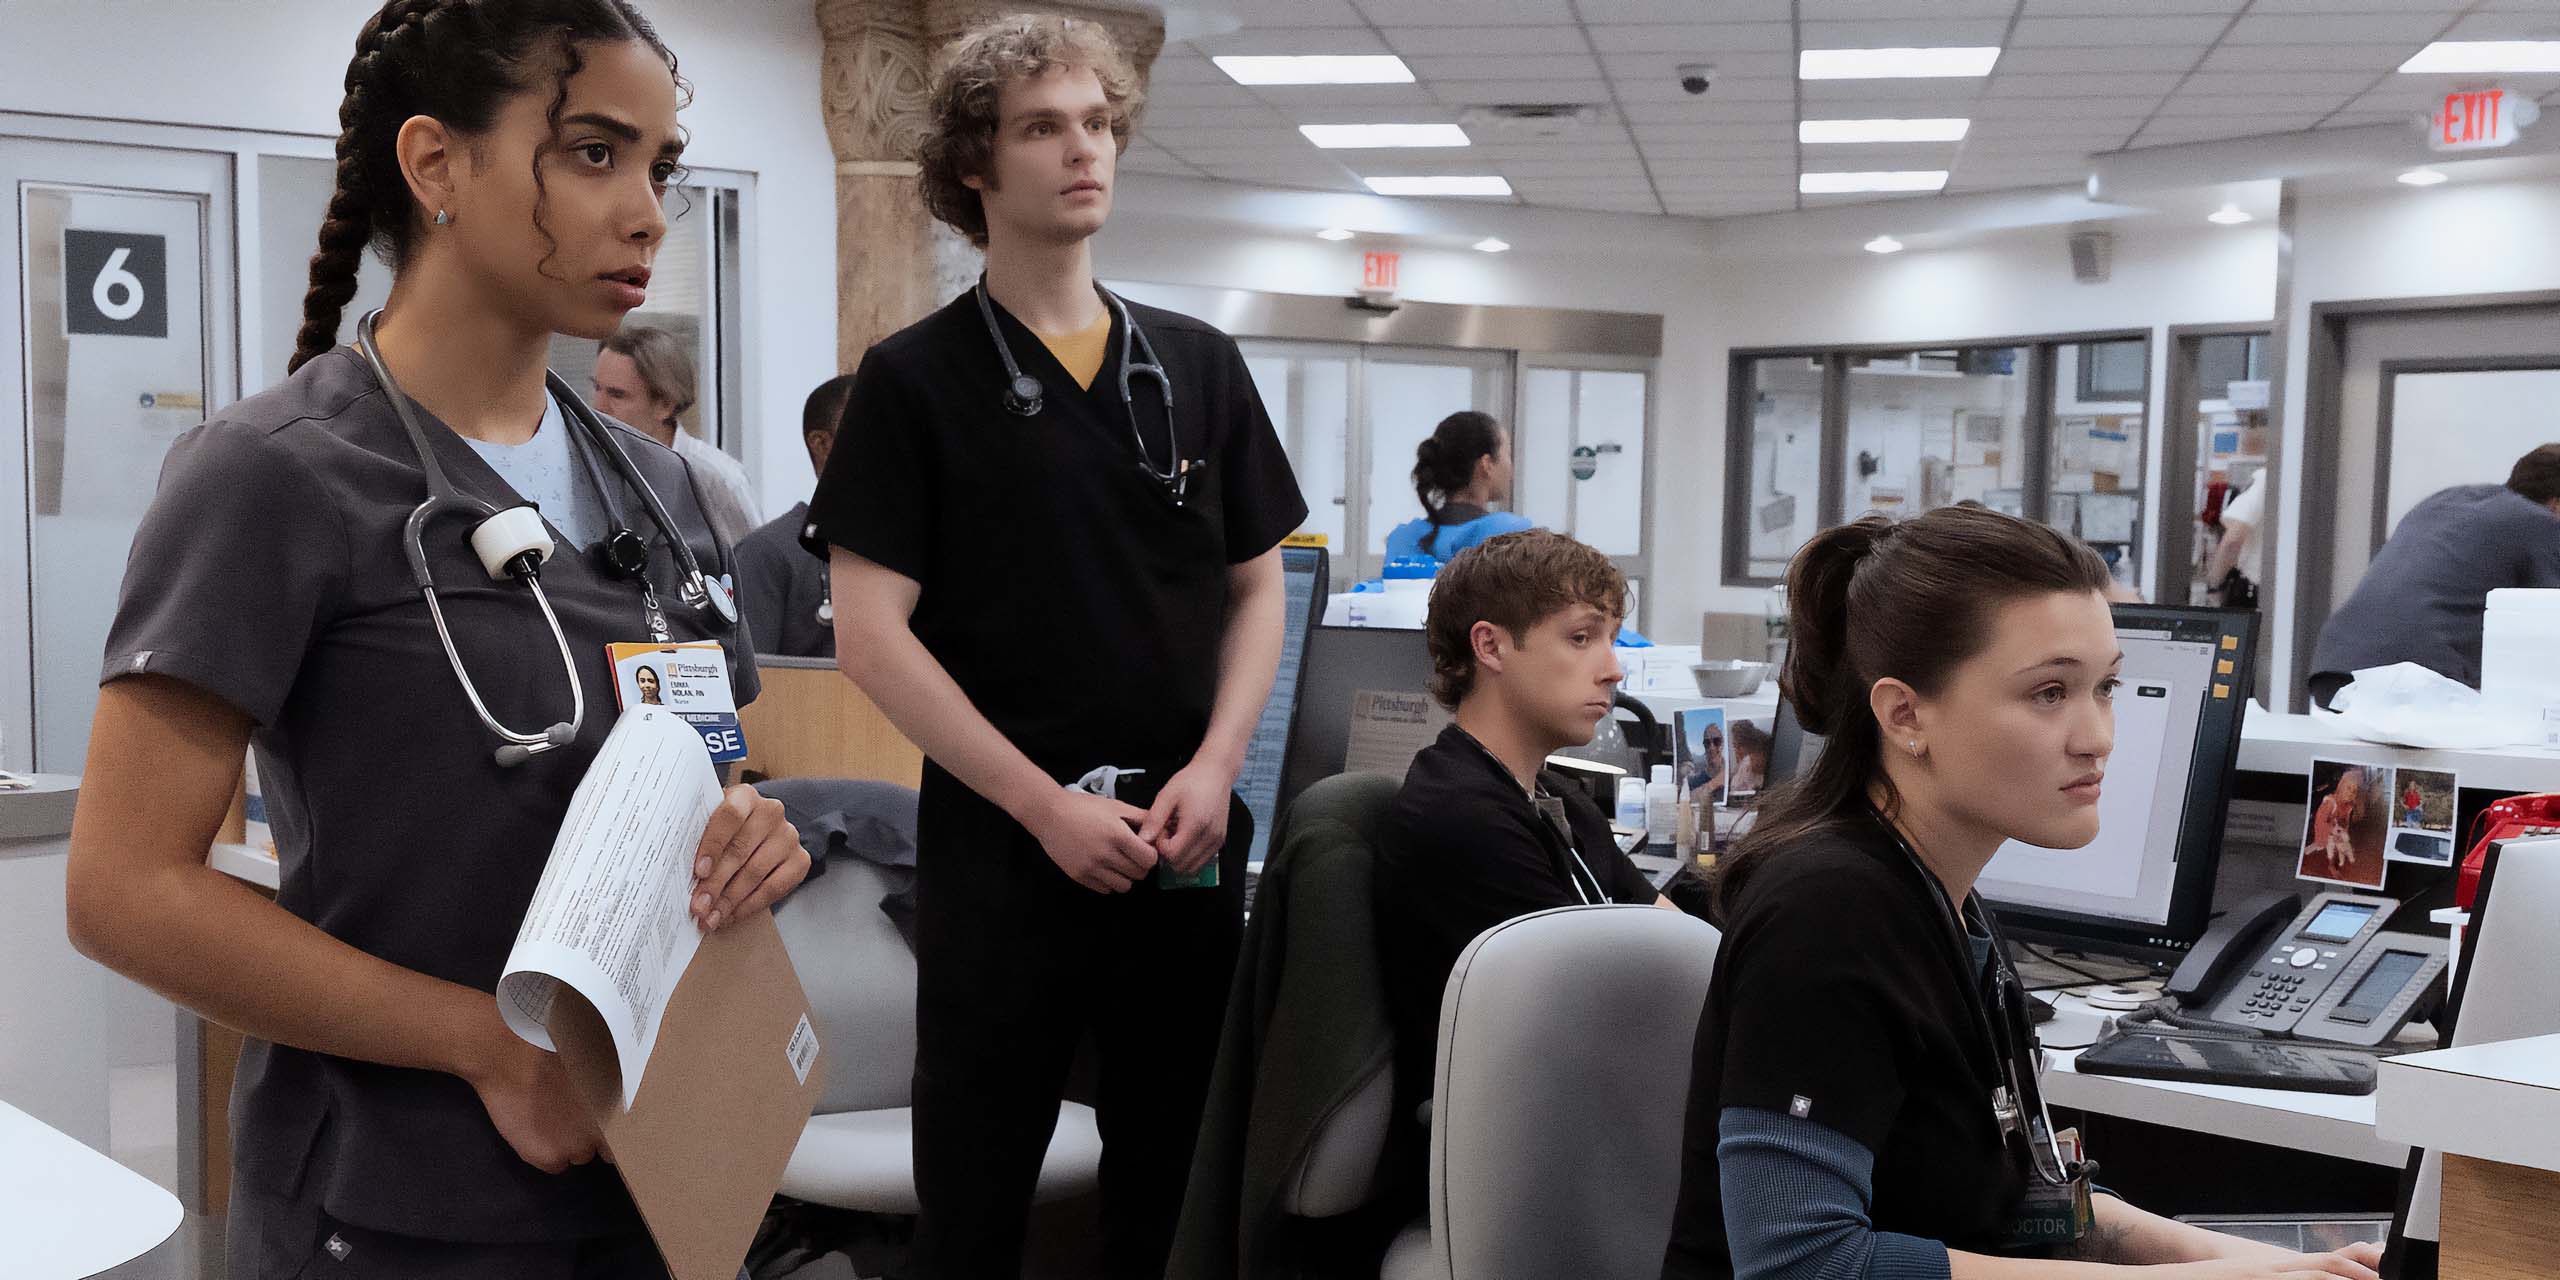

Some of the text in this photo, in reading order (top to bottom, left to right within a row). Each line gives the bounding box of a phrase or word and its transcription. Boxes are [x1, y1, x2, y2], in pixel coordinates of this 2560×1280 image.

[2444, 89, 2505, 144] EXIT
[1364, 253, 1400, 287] EXIT
[92, 247, 145, 321] 6
[678, 663, 718, 674] Pittsburgh
[1372, 695, 1428, 713] Pittsburgh
[2004, 1218, 2067, 1235] OCTOR
